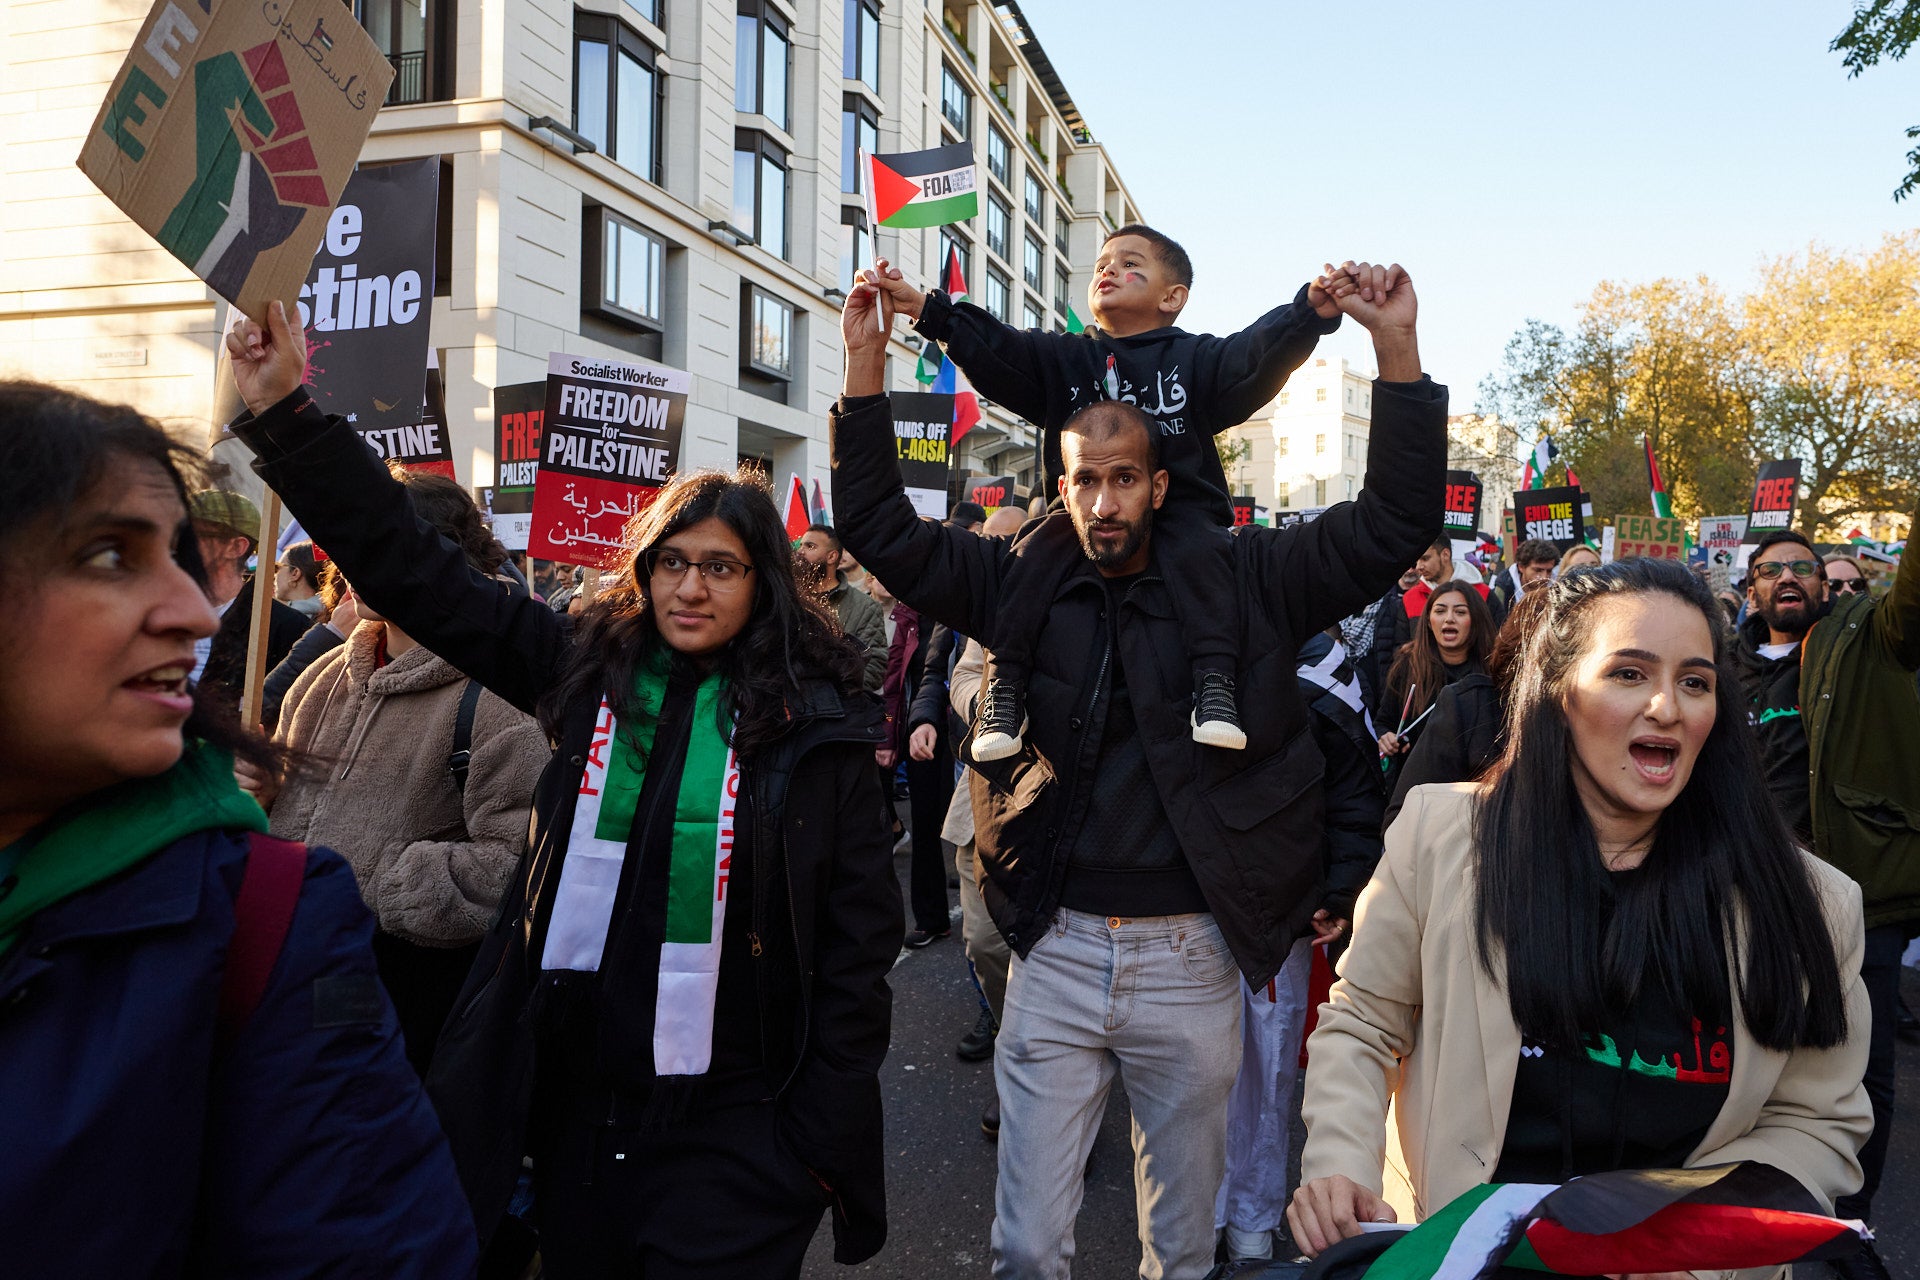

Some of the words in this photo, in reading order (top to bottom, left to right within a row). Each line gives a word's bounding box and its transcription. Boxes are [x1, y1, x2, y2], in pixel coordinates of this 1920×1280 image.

[263, 1, 367, 110] فلسطين
[923, 175, 952, 198] FOA
[559, 384, 670, 431] FREEDOM
[357, 424, 442, 459] STINE
[601, 423, 620, 440] for
[926, 422, 948, 441] OFF
[547, 433, 670, 481] PALESTINE
[562, 482, 640, 518] الحرية
[971, 486, 1005, 507] STOP
[1753, 477, 1795, 512] FREE
[1525, 504, 1550, 522] END
[1548, 502, 1573, 520] THE
[1750, 510, 1790, 528] PALESTINE
[1525, 518, 1574, 541] SIEGE
[1617, 517, 1681, 543] CEASE
[1716, 523, 1732, 532] END
